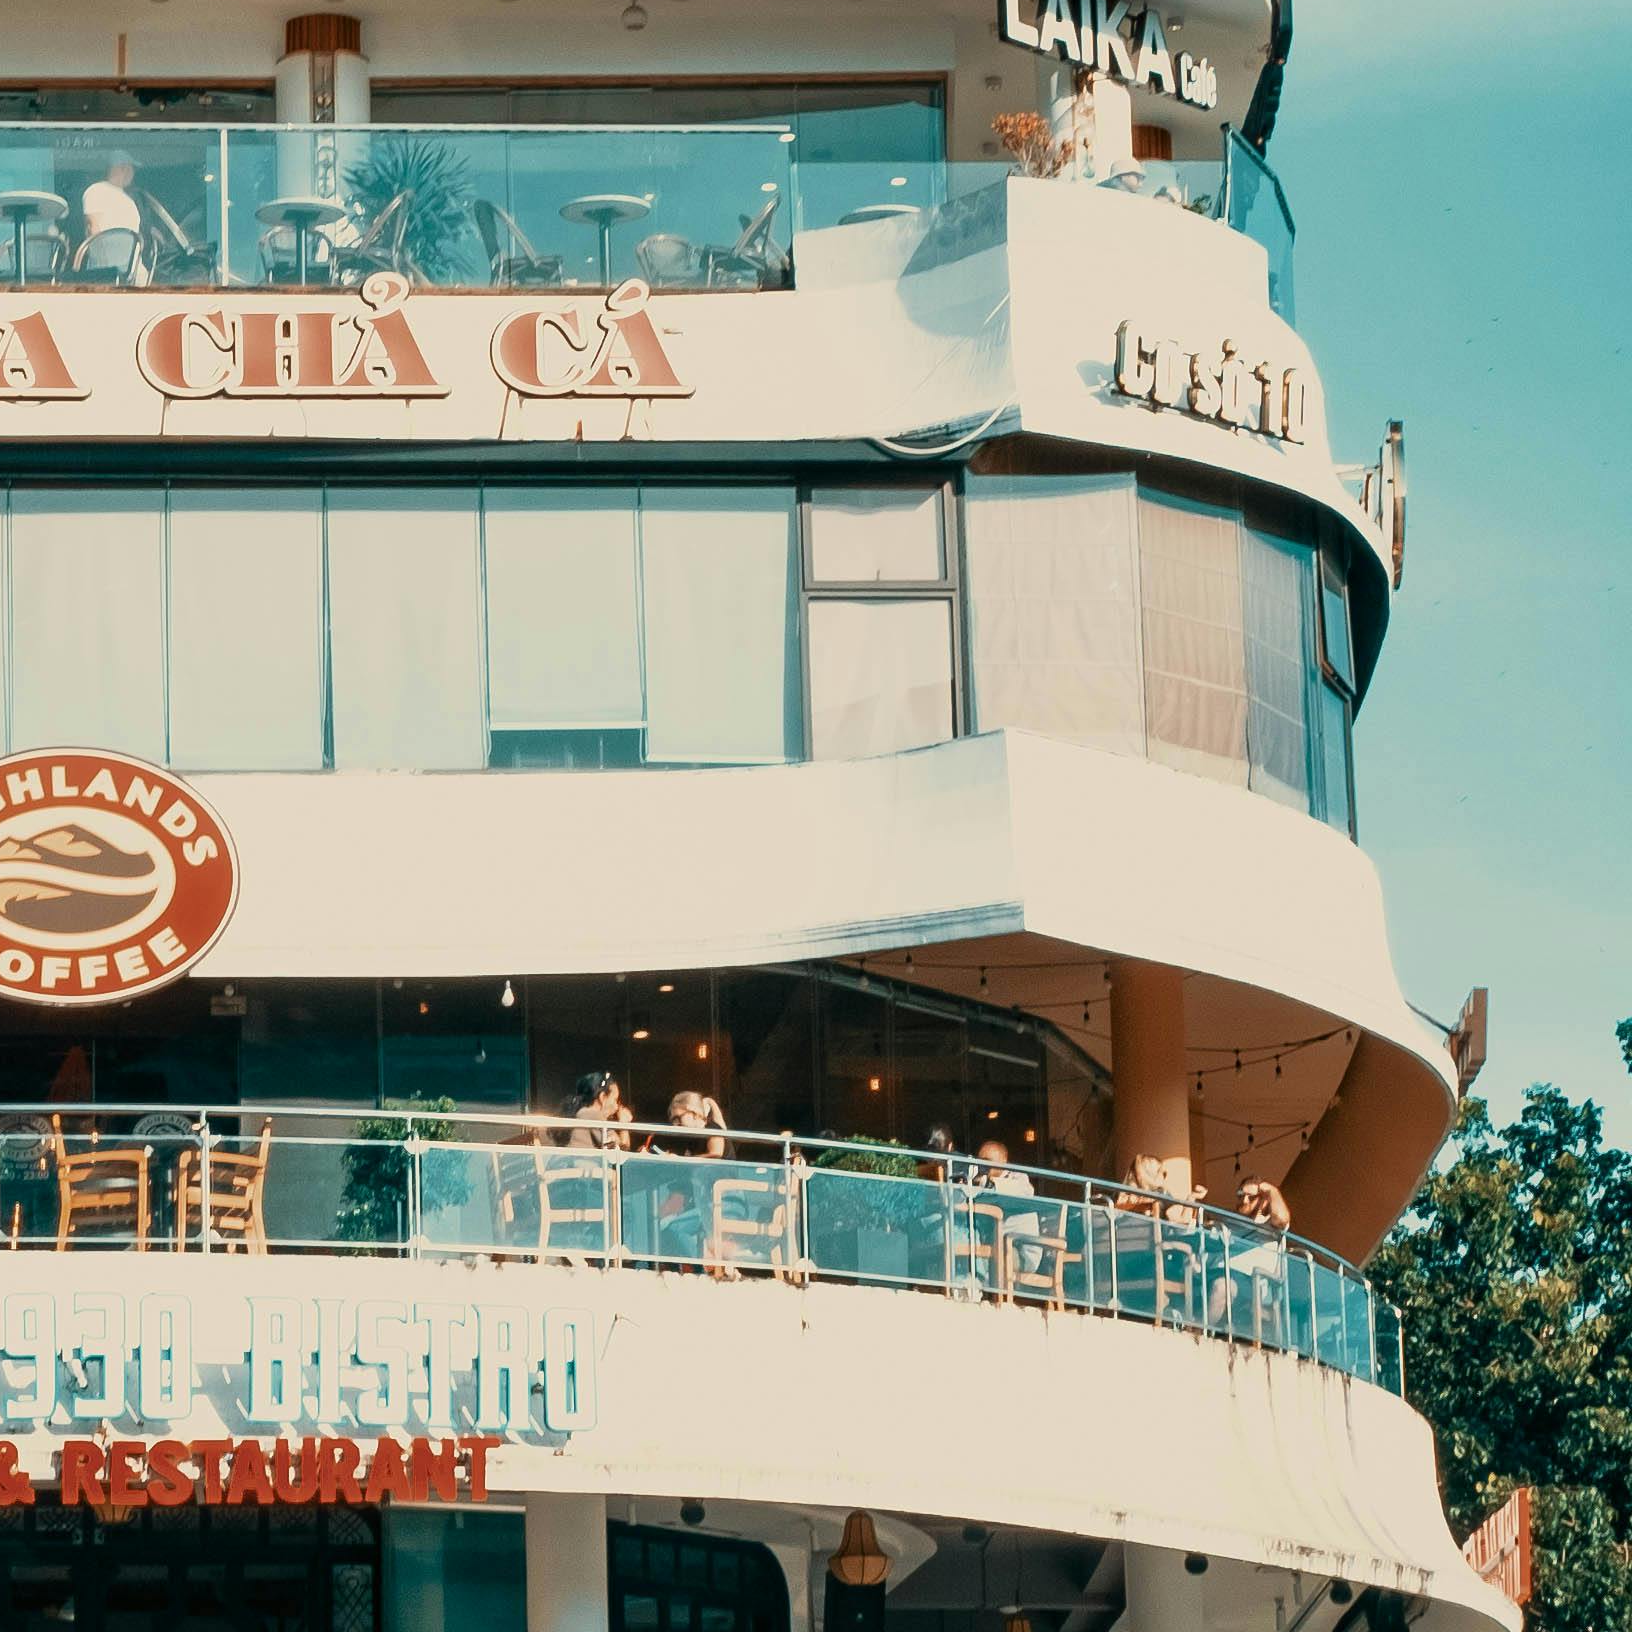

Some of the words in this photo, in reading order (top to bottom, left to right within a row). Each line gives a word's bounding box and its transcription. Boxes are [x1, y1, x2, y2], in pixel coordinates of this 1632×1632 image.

[136, 272, 452, 398] CHẢ
[490, 279, 696, 399] CÁ
[245, 1296, 598, 1432] BISTRO
[62, 1435, 501, 1506] RESTAURANT
